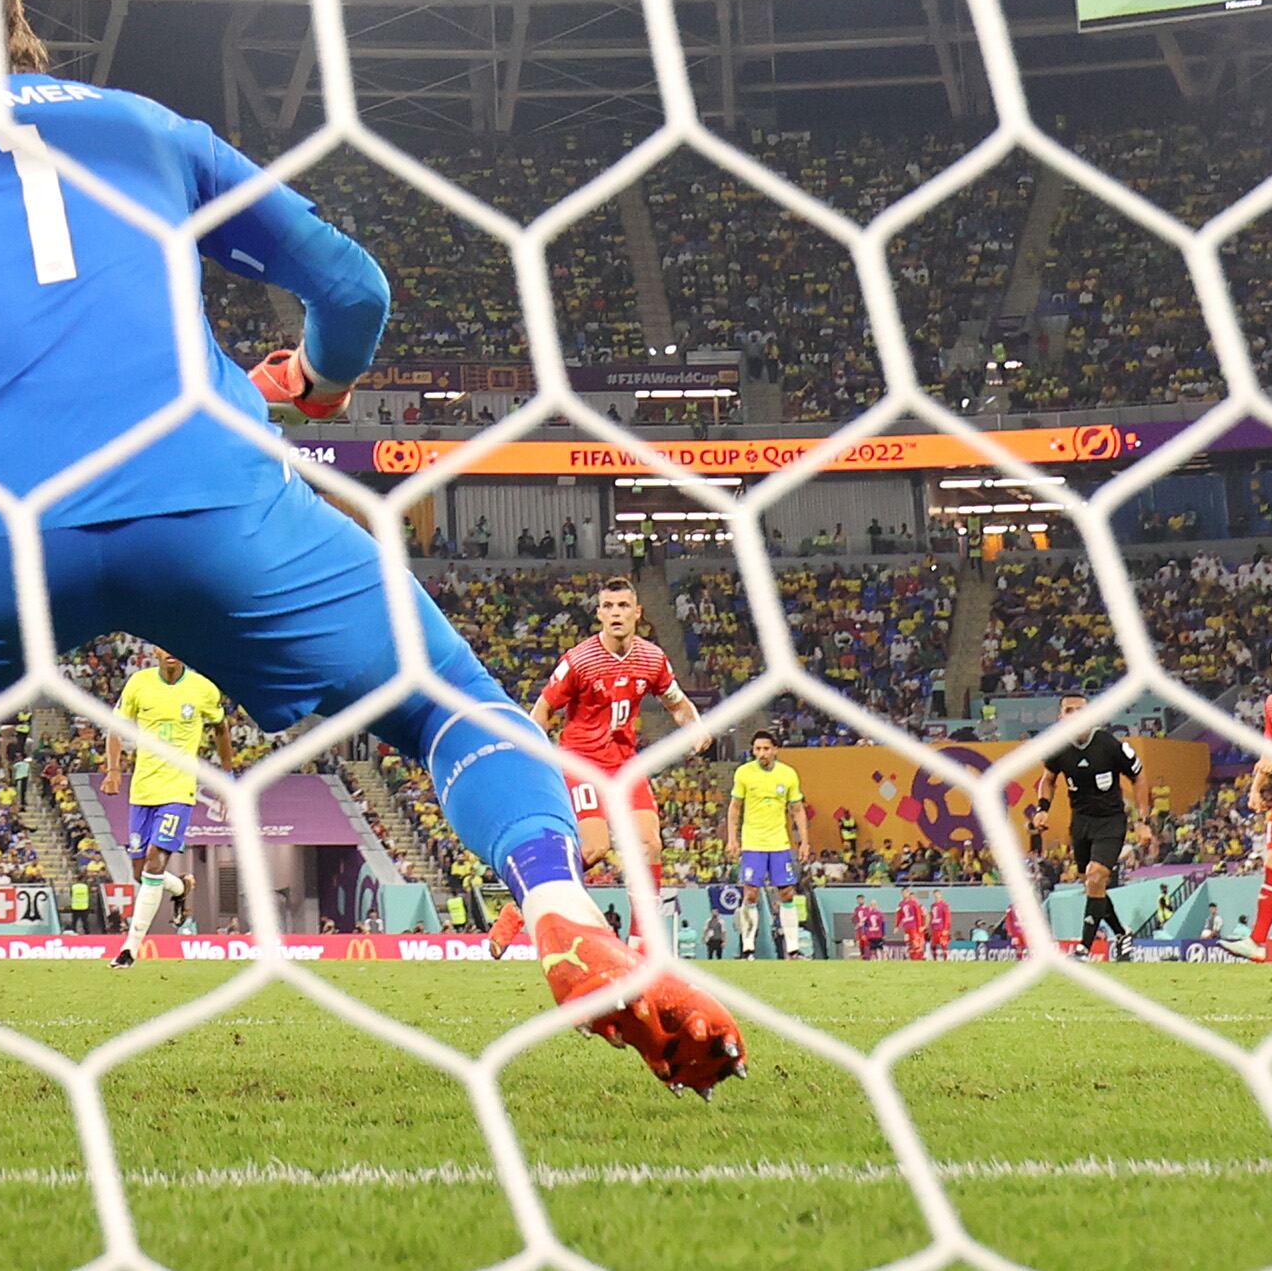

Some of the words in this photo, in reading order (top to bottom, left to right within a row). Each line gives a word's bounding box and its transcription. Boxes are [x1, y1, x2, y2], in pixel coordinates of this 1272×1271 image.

[607, 372, 718, 387] #FIFAWorldCup
[288, 446, 336, 464] 82:14
[570, 451, 614, 466] FIFA
[700, 450, 740, 465] CUP
[610, 698, 631, 731] 10
[571, 782, 599, 813] 10
[159, 812, 180, 837] 21
[9, 938, 105, 959] Deliver
[181, 940, 225, 960] We
[228, 940, 325, 960] Dever
[398, 939, 443, 960] We
